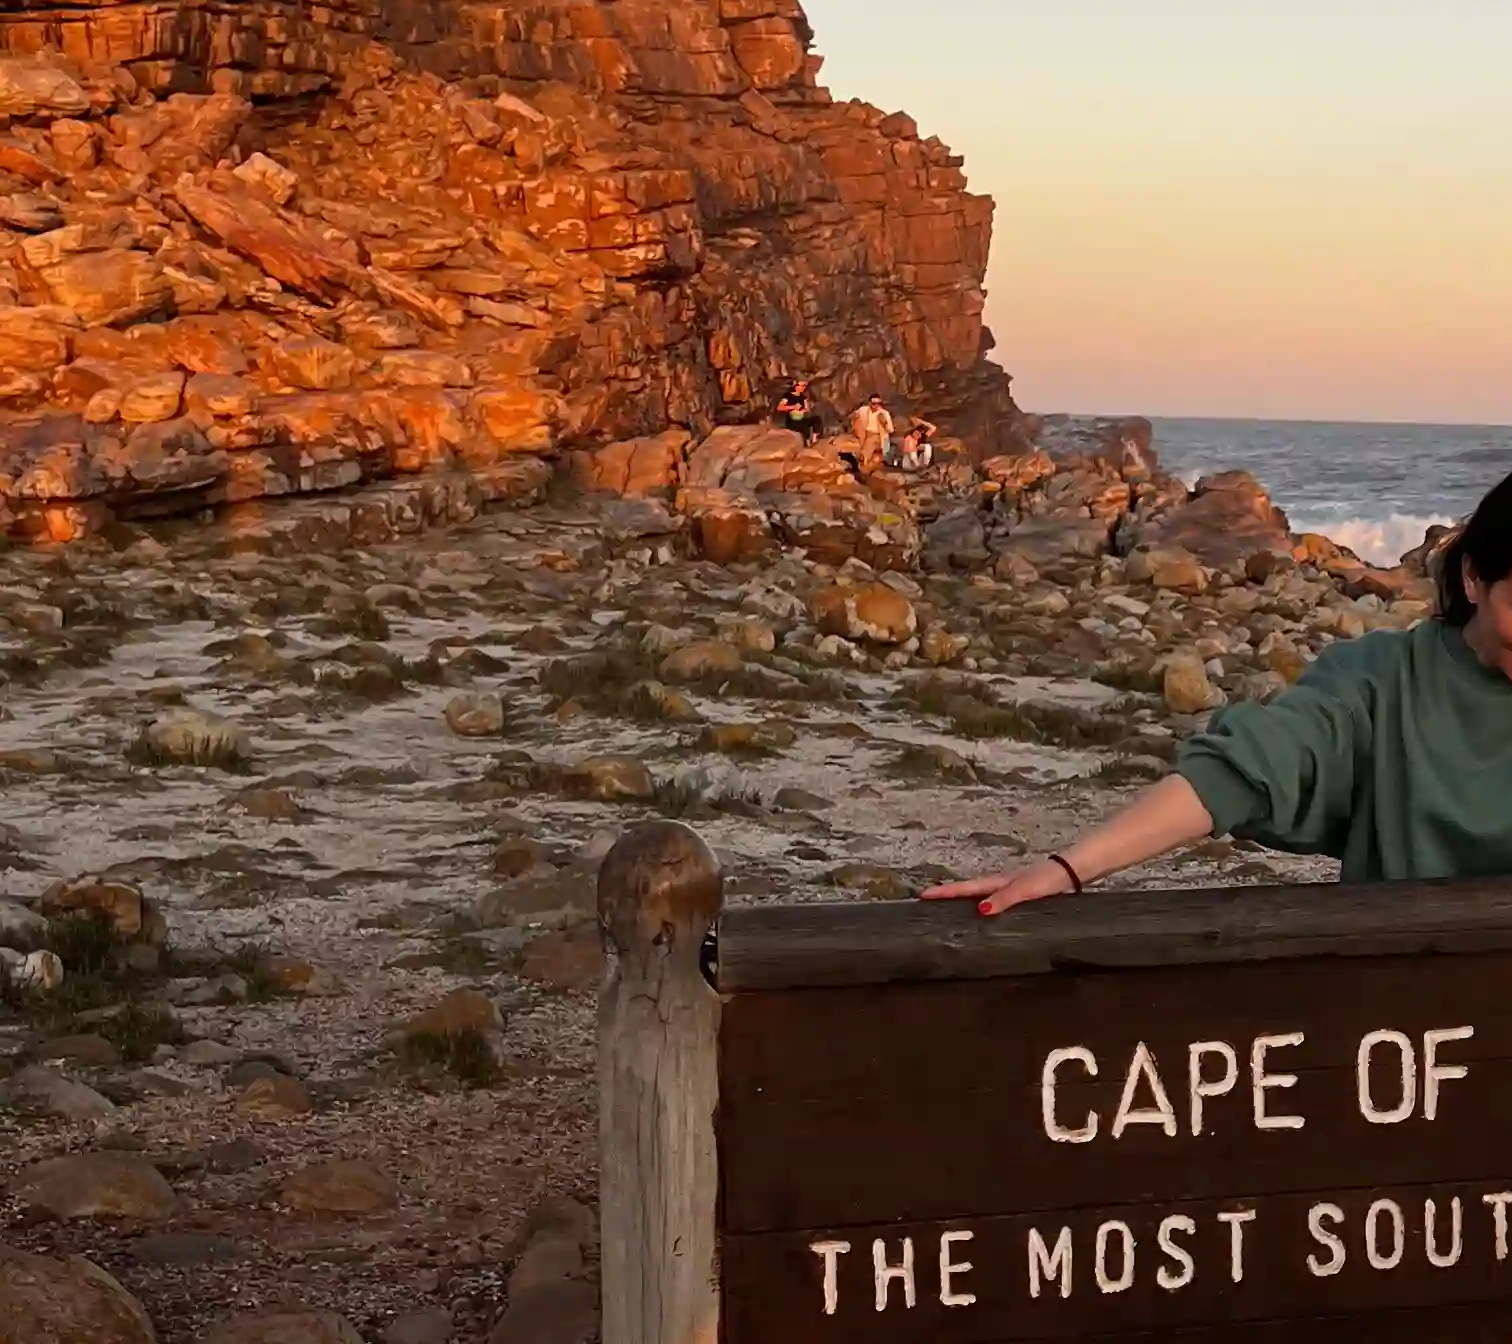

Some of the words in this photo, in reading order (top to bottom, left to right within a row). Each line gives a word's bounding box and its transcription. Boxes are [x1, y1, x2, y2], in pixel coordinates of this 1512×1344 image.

[1041, 1031, 1306, 1144] CAPE
[1357, 1025, 1474, 1124] OF
[810, 1230, 977, 1315] THE
[1028, 1206, 1257, 1299] MOST
